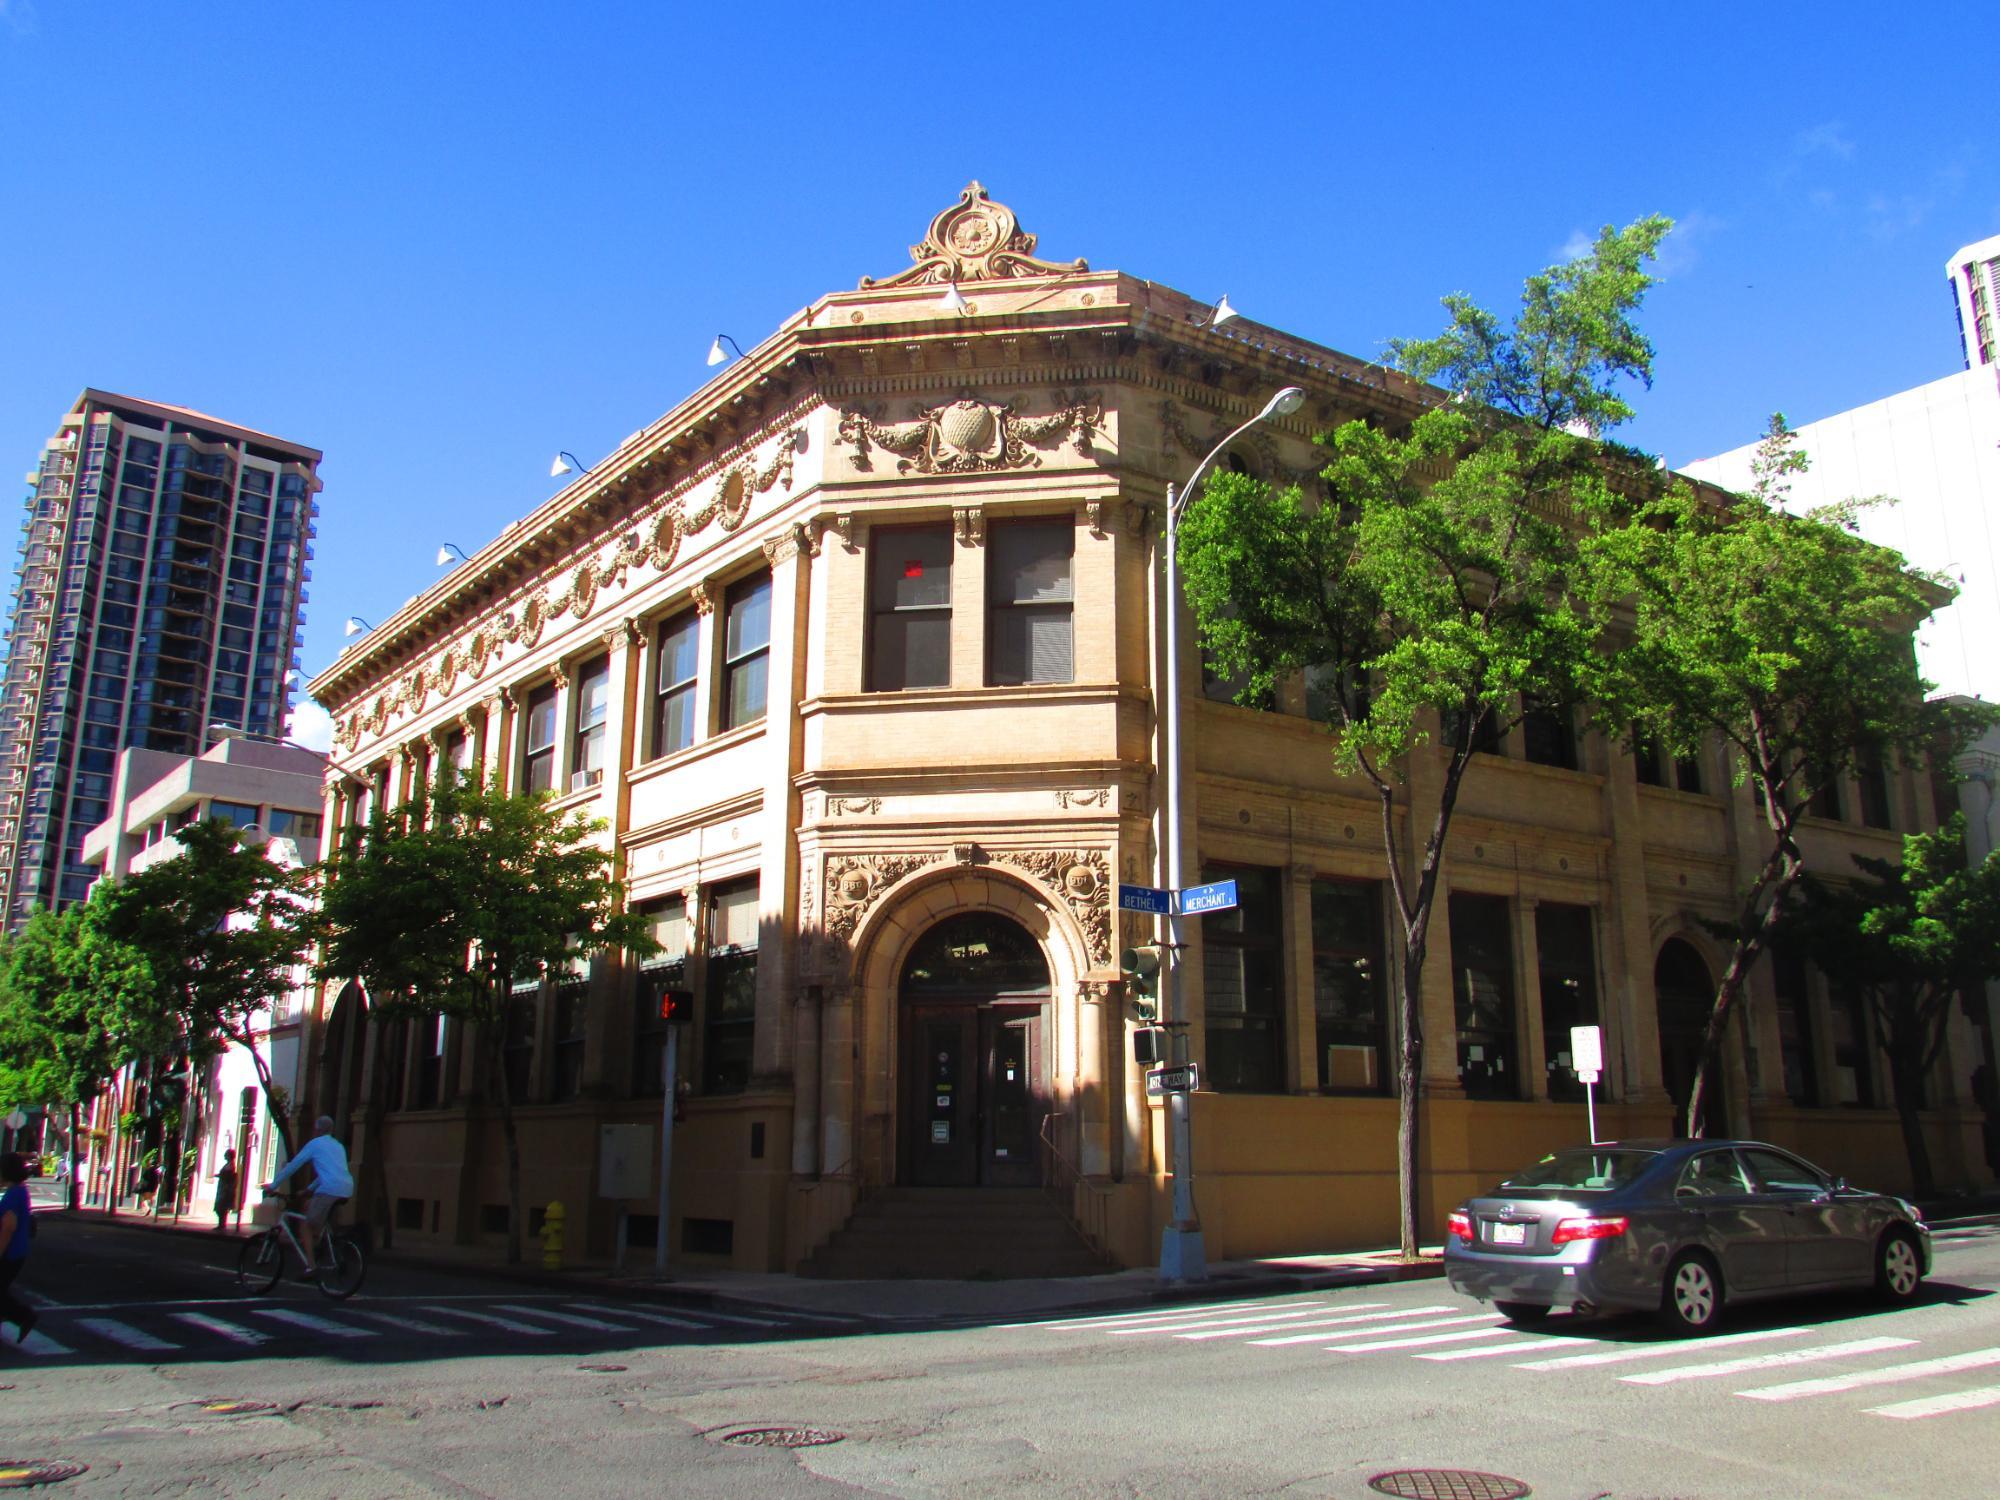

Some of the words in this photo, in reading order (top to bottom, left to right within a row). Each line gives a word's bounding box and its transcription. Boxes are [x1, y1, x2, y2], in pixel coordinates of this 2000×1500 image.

[1124, 895, 1157, 910] BETHEL
[1185, 892, 1226, 911] MERCHANT
[1168, 1073, 1184, 1086] WAY
